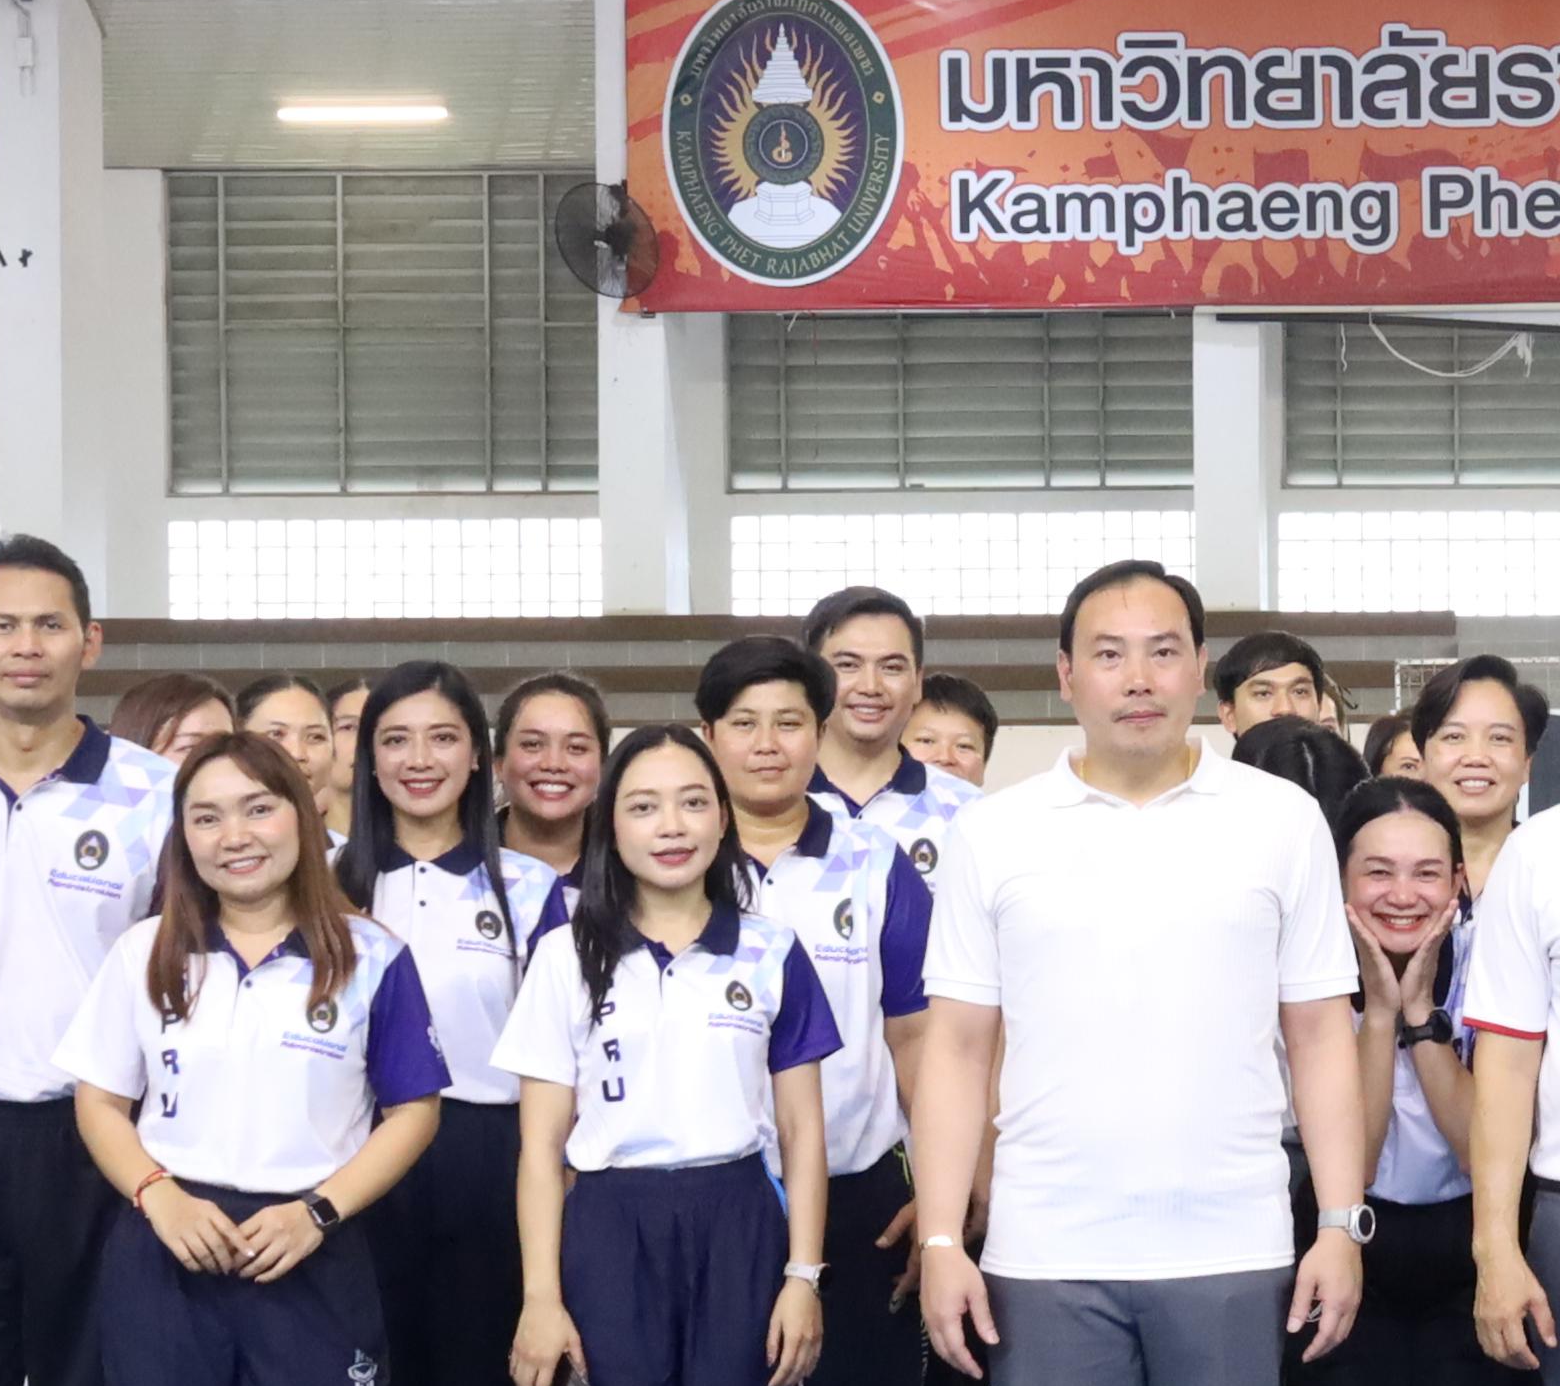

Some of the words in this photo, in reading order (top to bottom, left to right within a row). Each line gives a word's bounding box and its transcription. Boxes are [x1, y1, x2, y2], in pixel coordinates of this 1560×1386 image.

[676, 130, 721, 237] KAMPHAENG
[719, 233, 763, 270] PHET
[766, 234, 852, 278] RAJABHAT
[846, 132, 891, 236] UNIVERSITY
[956, 175, 1393, 250] Kamphaeng
